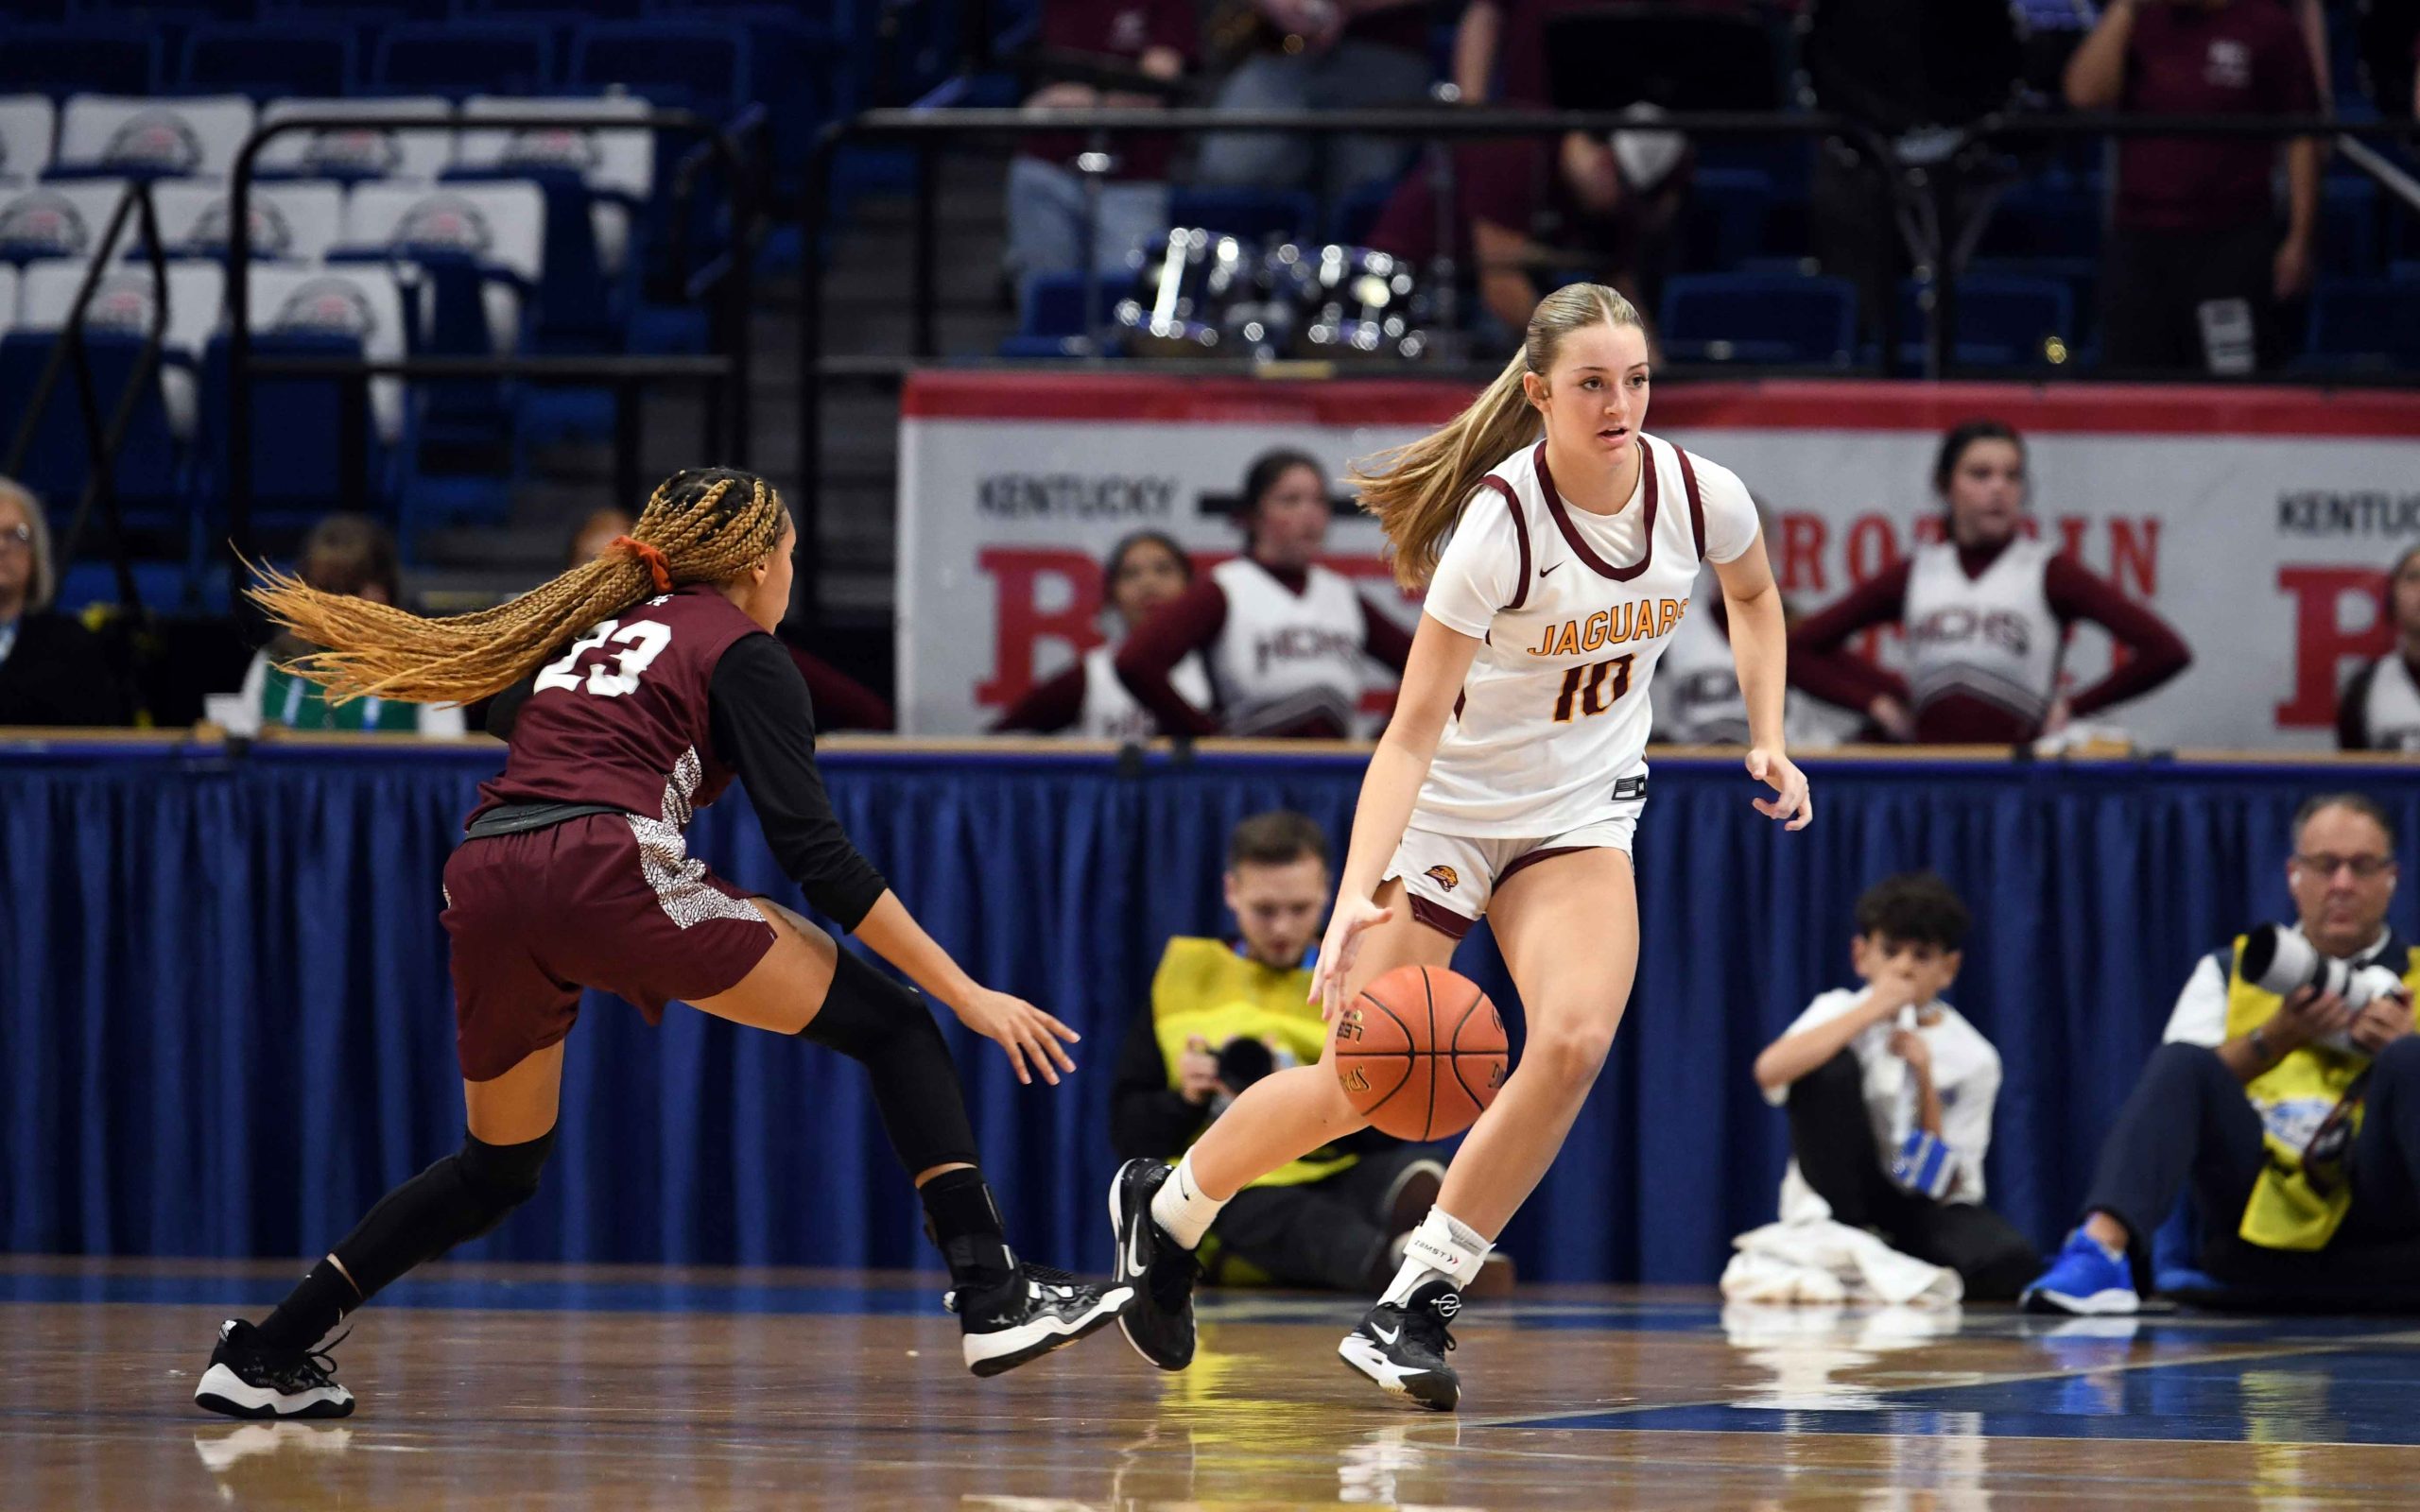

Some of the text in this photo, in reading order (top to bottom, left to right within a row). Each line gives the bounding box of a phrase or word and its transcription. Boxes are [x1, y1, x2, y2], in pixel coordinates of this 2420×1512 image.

[977, 477, 1178, 519] KENTUCKY
[533, 619, 672, 697] 23
[1552, 652, 1637, 724] 10
